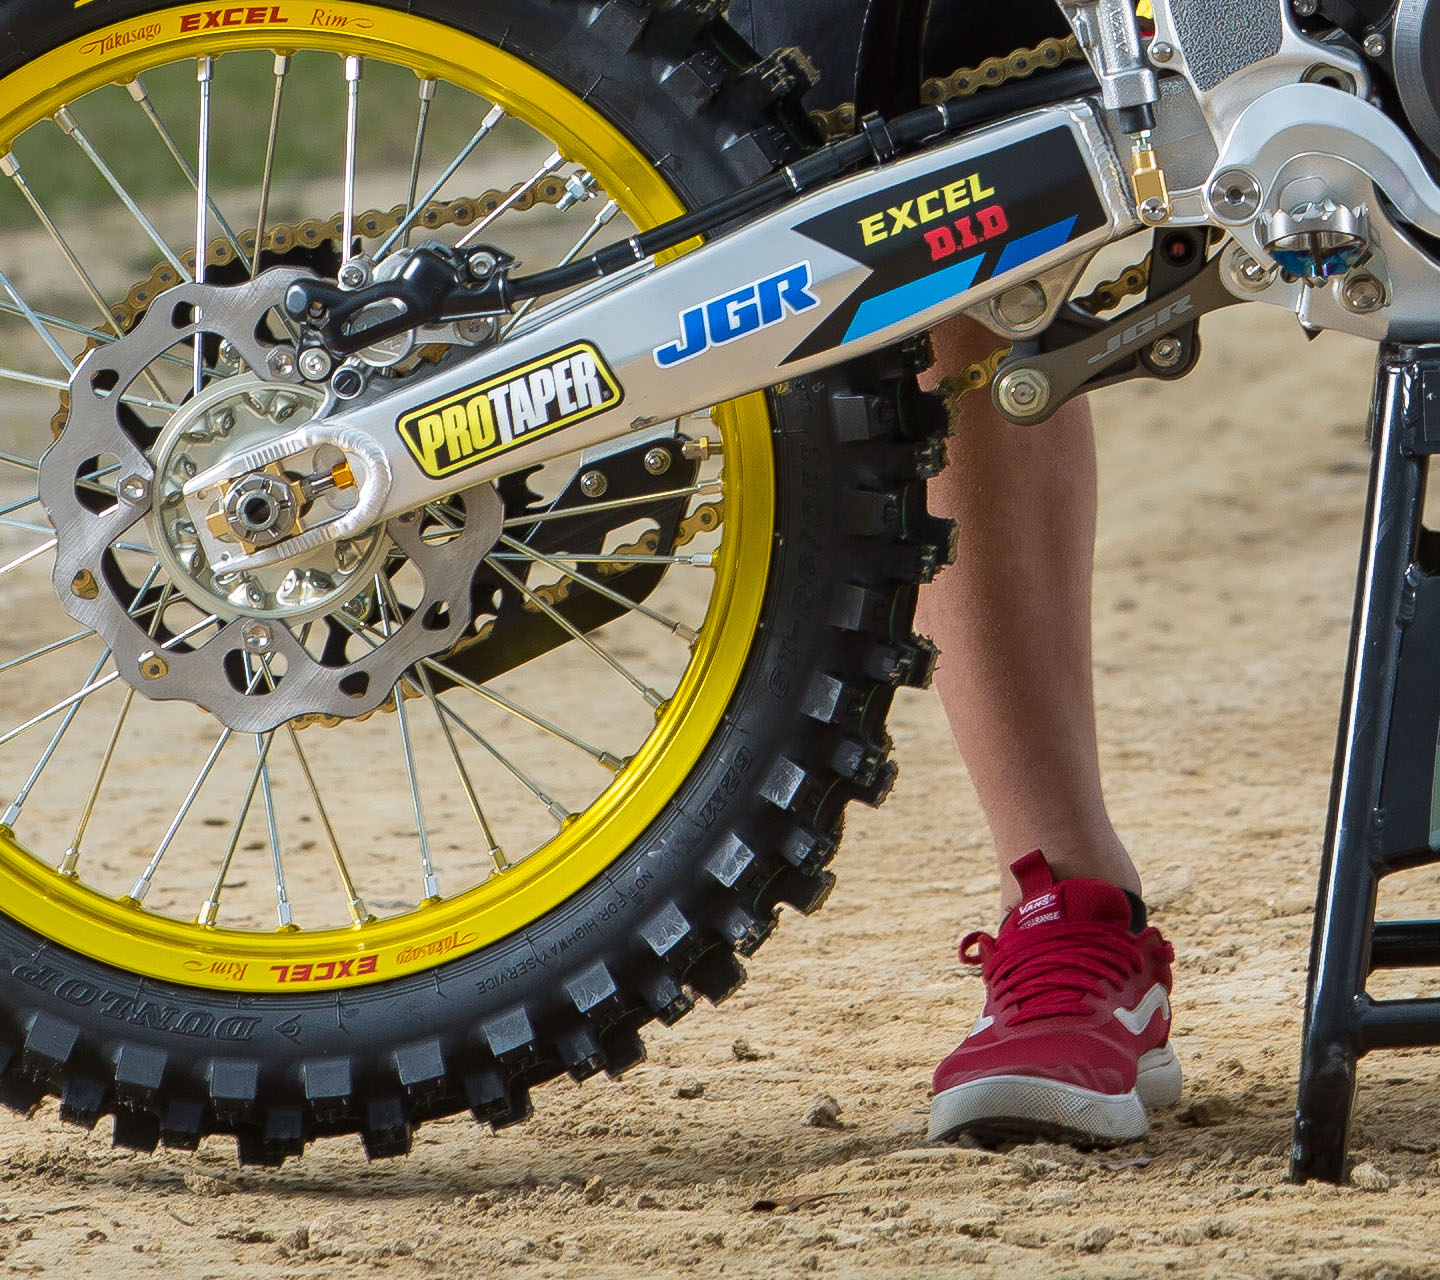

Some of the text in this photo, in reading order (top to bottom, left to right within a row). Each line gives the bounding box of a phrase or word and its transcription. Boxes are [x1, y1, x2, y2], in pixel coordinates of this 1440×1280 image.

[79, 6, 374, 56] Takasago EXCEL Rim
[857, 173, 996, 247] EXCEL
[655, 261, 820, 369] JGR
[1087, 294, 1194, 365] JGR
[417, 351, 602, 474] PROTAPER
[11, 961, 262, 1041] DUNLOP
[269, 954, 380, 984] EXCEL
